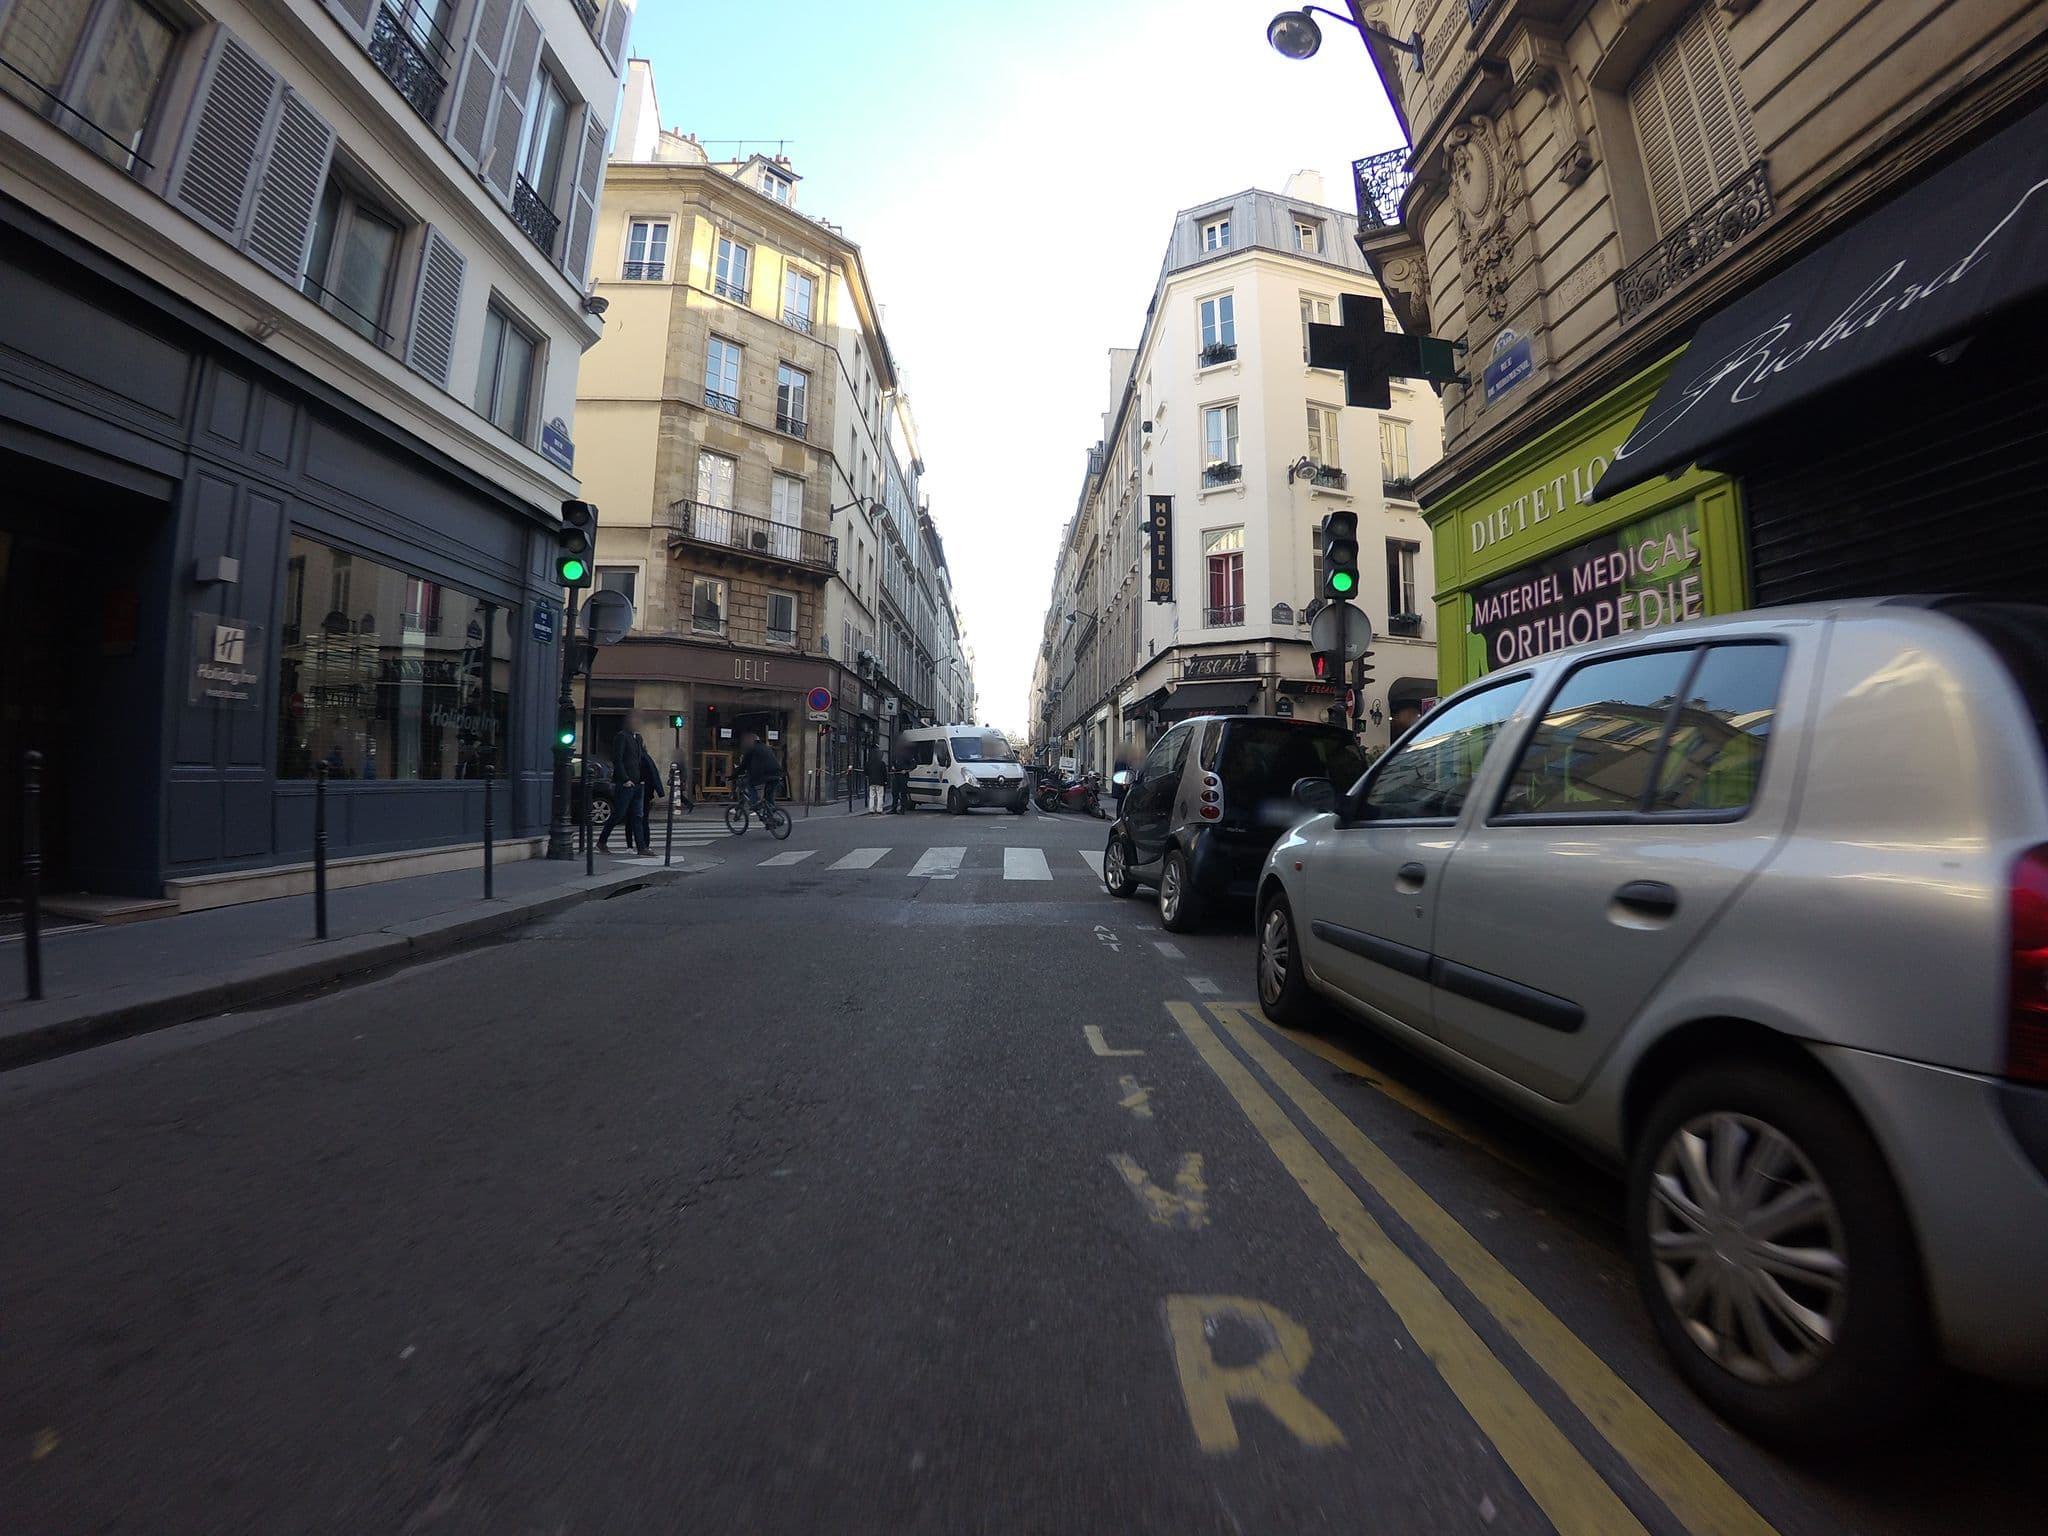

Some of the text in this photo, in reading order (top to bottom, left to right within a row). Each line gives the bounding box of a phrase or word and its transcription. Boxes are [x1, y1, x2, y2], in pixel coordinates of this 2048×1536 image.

[1616, 178, 2048, 461] Richard
[1155, 502, 1167, 571] HOTEL
[1474, 525, 1698, 627] MATERIEL MEDICAL
[1495, 575, 1702, 664] ORTHOPEDIE
[734, 658, 770, 682] DELF
